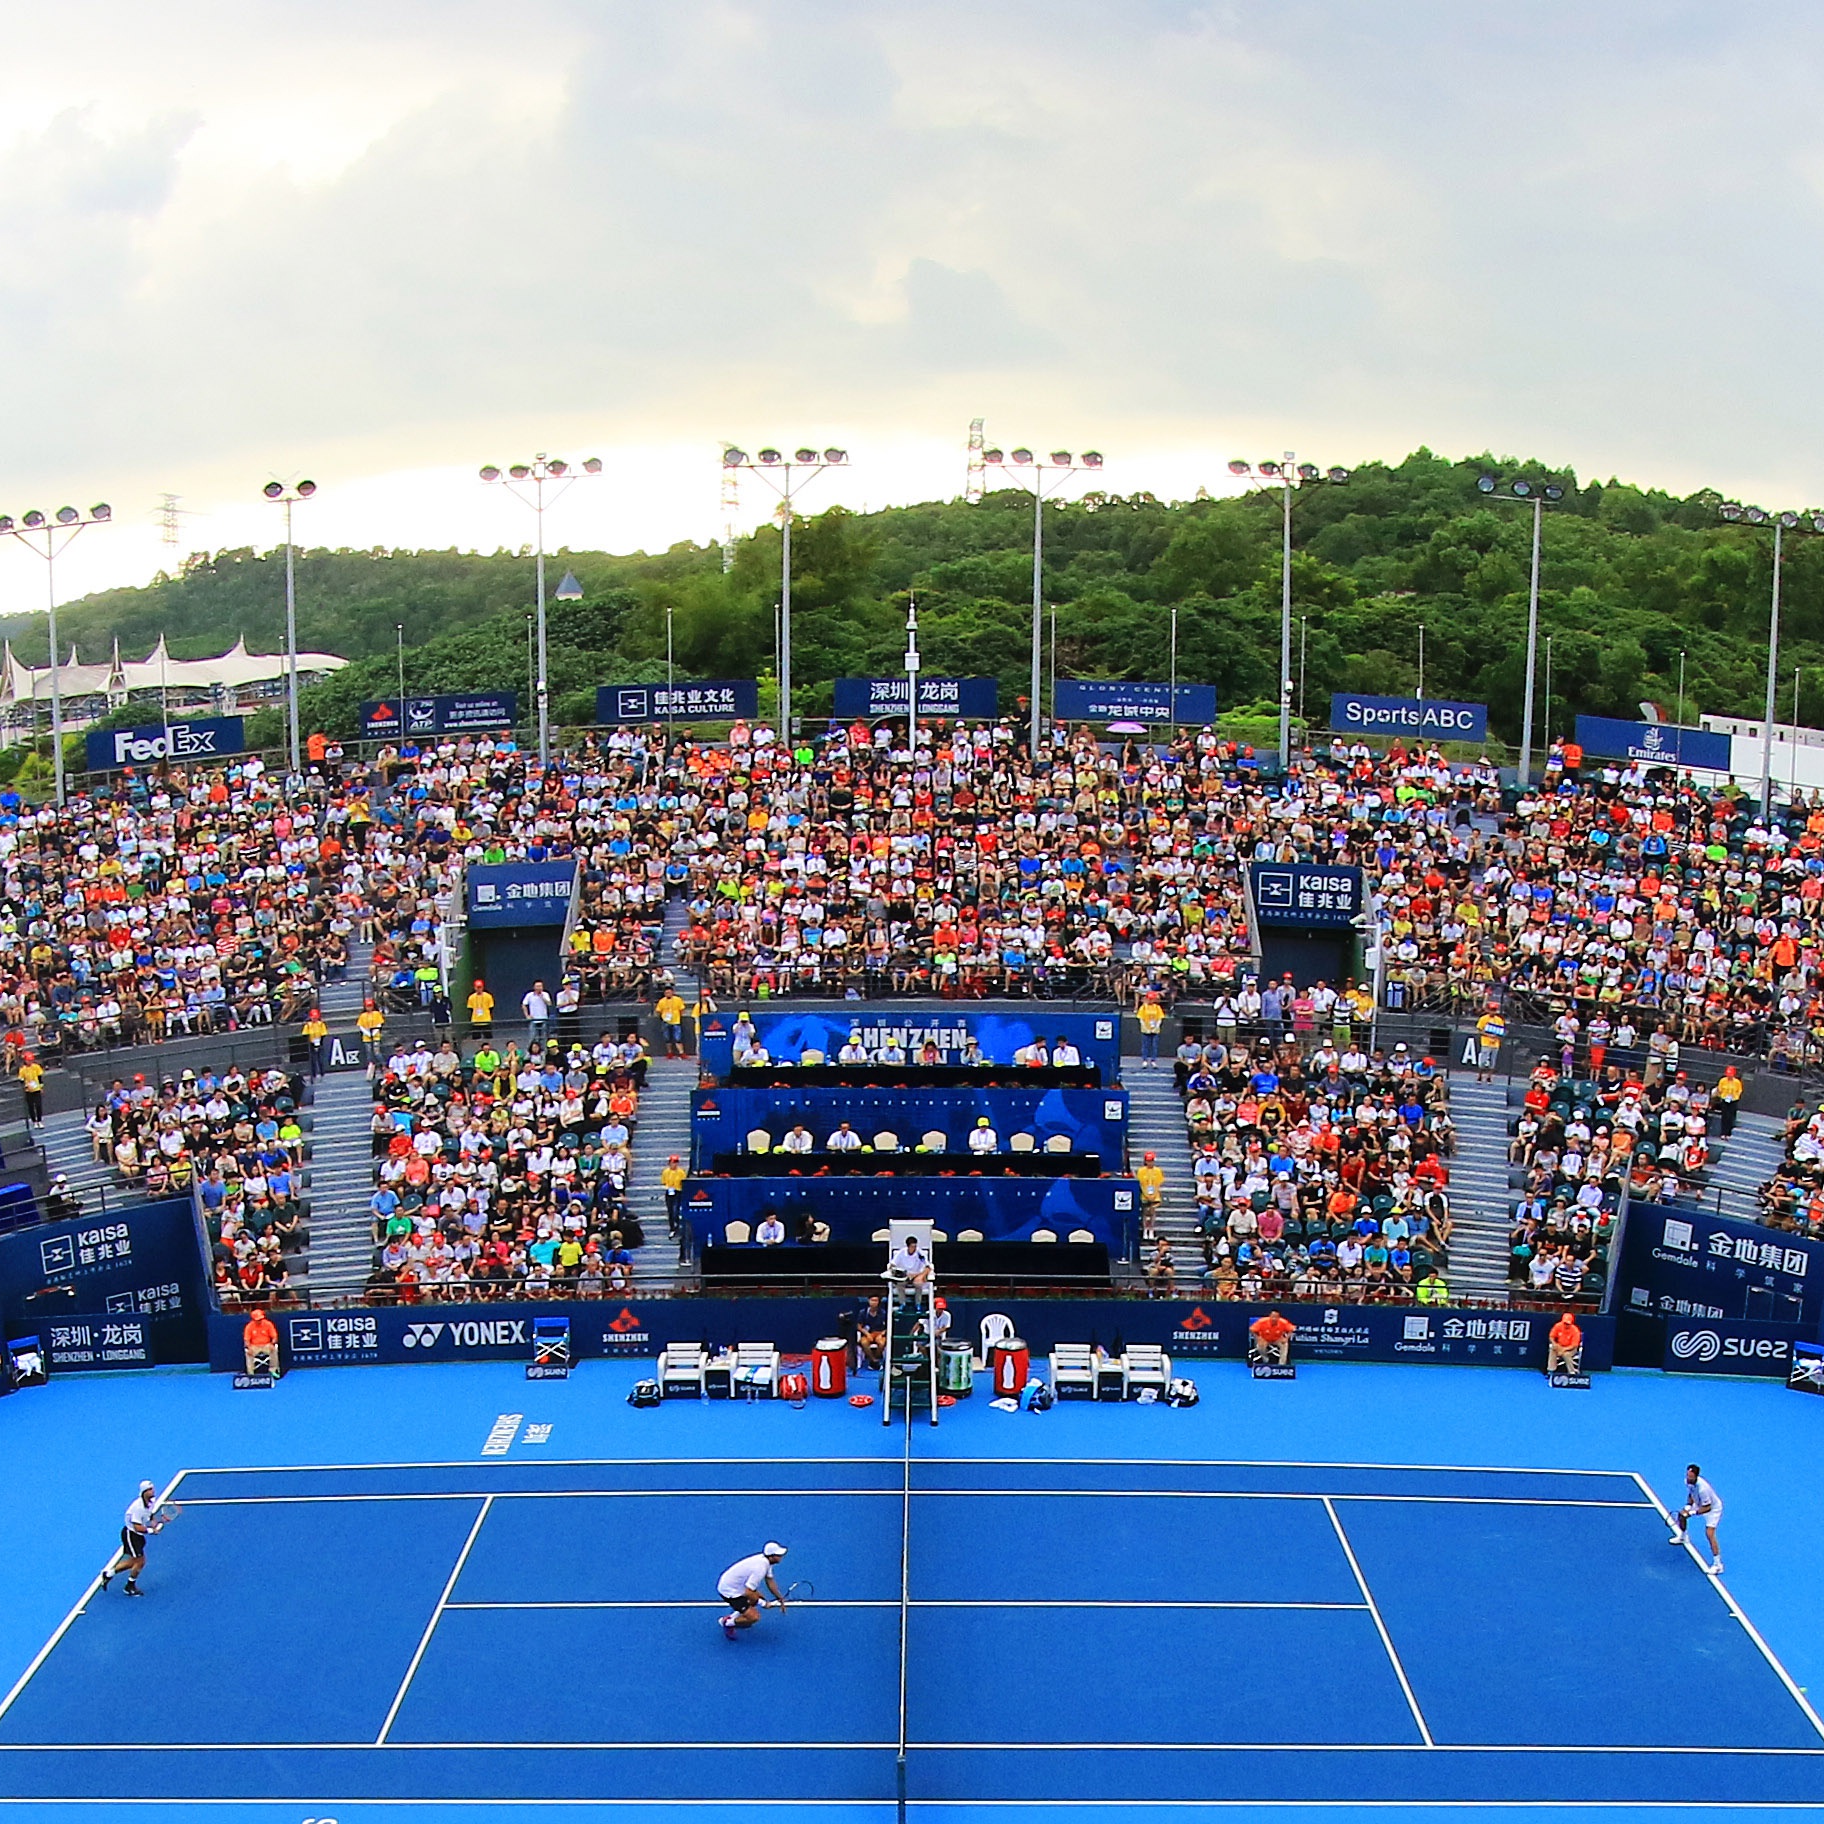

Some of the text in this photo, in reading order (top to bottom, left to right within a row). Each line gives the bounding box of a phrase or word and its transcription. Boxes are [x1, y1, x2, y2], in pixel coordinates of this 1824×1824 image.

[654, 688, 735, 705] 佳兆业文化
[869, 681, 960, 701] 深圳 龙岗
[654, 703, 735, 715] KASA CULTURE
[114, 724, 216, 763] FedEx
[1627, 745, 1677, 762] Emirates
[506, 880, 571, 900] 金地集团
[1298, 893, 1352, 910] 佳兆业
[850, 1027, 968, 1049] SHENZHEN
[78, 1239, 132, 1265] 佳兆业
[1651, 1247, 1699, 1270] Gemdale
[1707, 1231, 1810, 1278] 金地集团
[448, 1320, 526, 1345] YONEX
[1442, 1318, 1531, 1342] 金地集团
[326, 1333, 378, 1349] 佳兆业
[1394, 1341, 1436, 1353] Gemdale
[1723, 1337, 1788, 1359] suez
